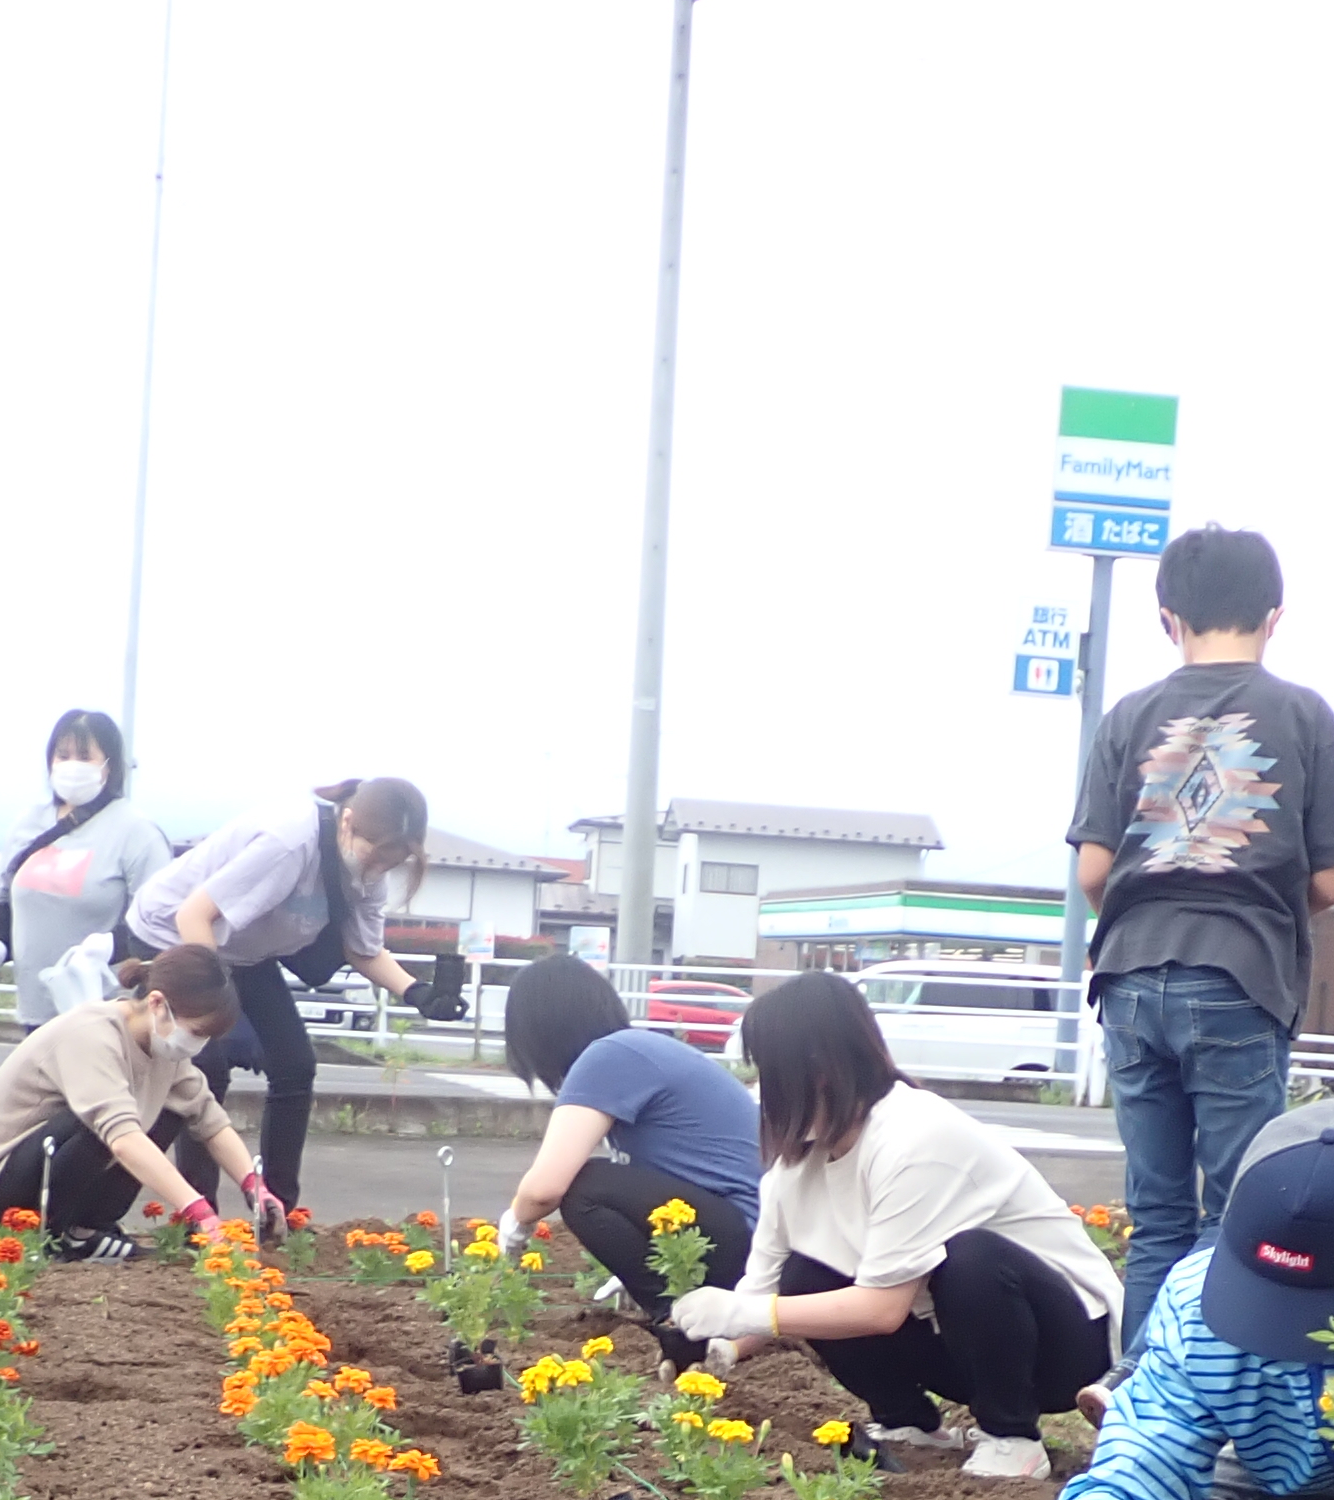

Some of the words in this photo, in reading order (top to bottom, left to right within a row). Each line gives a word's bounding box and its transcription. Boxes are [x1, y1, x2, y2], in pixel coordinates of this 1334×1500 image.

[1061, 453, 1170, 481] FamilyMart
[1064, 511, 1095, 543] 酒
[1102, 518, 1160, 546] たばこ
[1022, 628, 1070, 649] ATM
